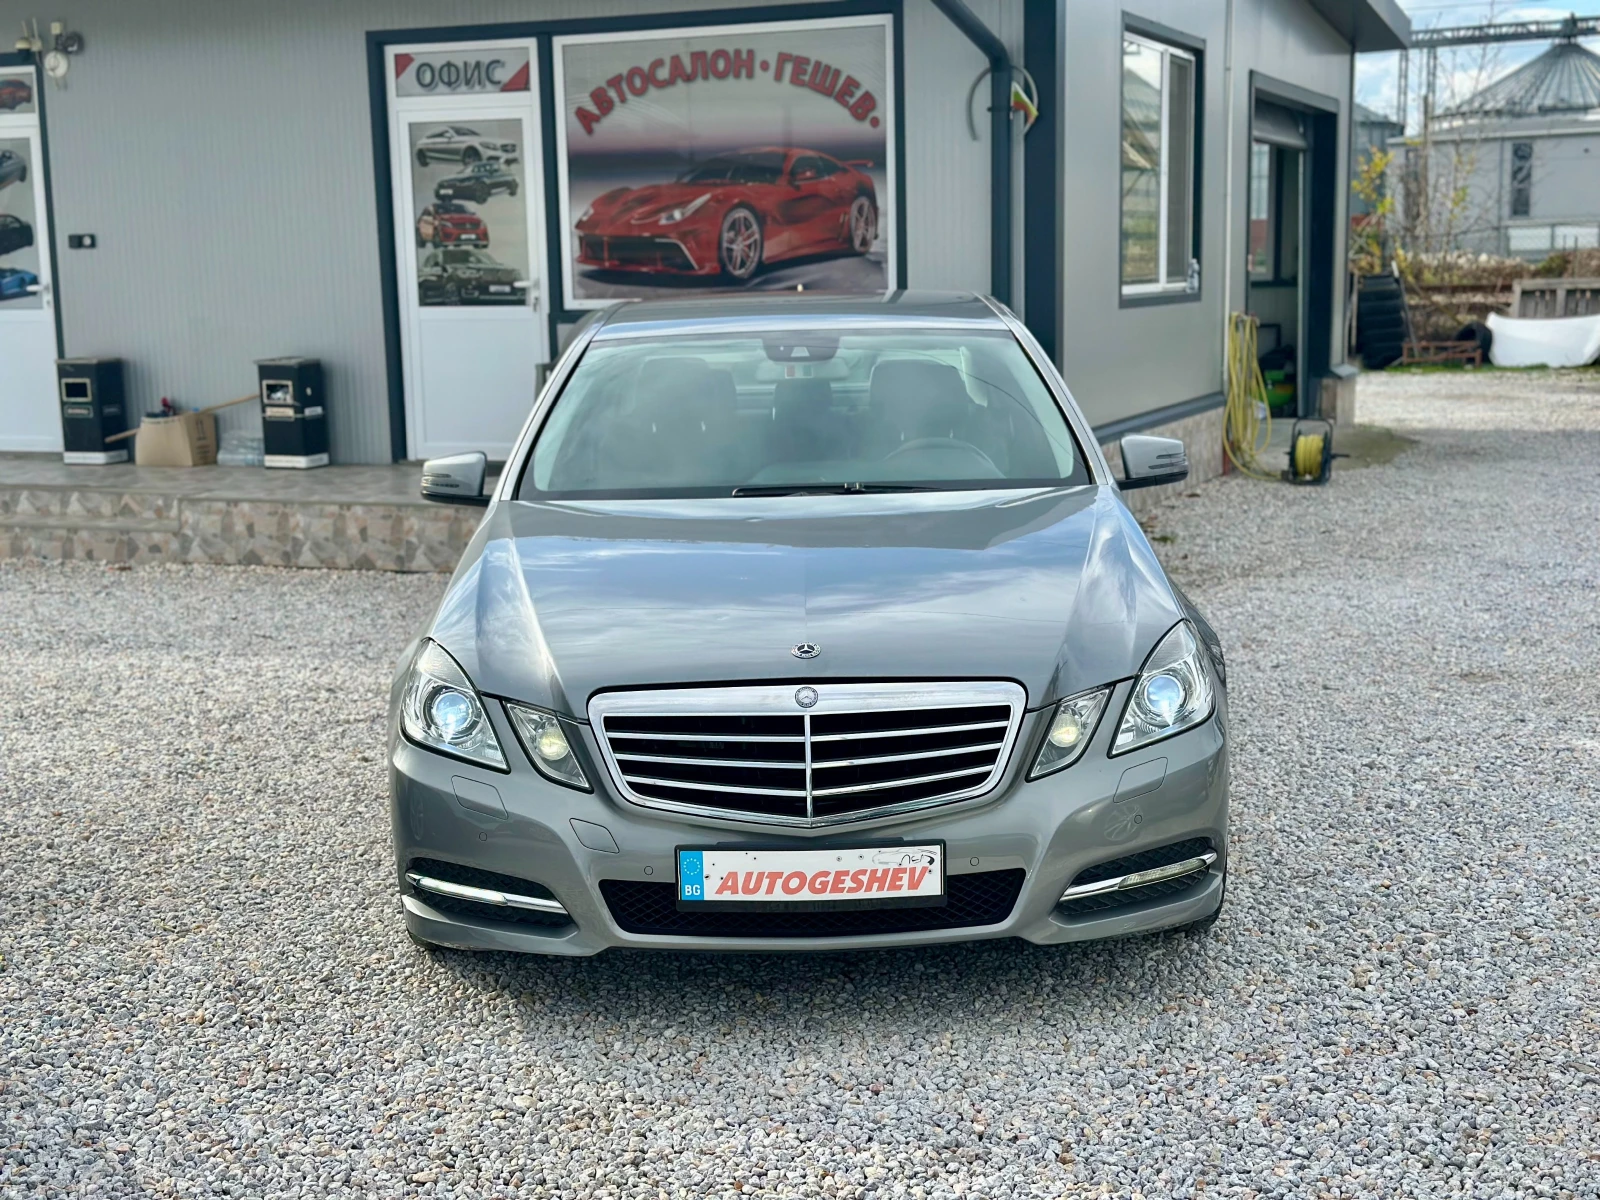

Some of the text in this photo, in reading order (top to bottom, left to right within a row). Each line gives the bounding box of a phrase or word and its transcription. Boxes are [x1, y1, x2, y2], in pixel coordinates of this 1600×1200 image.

[415, 59, 505, 89] ОФИС
[574, 48, 877, 135] АВТОСАЛОН ГЕШЕВ
[684, 884, 701, 896] BG
[714, 866, 930, 896] AUTOGESHEV
